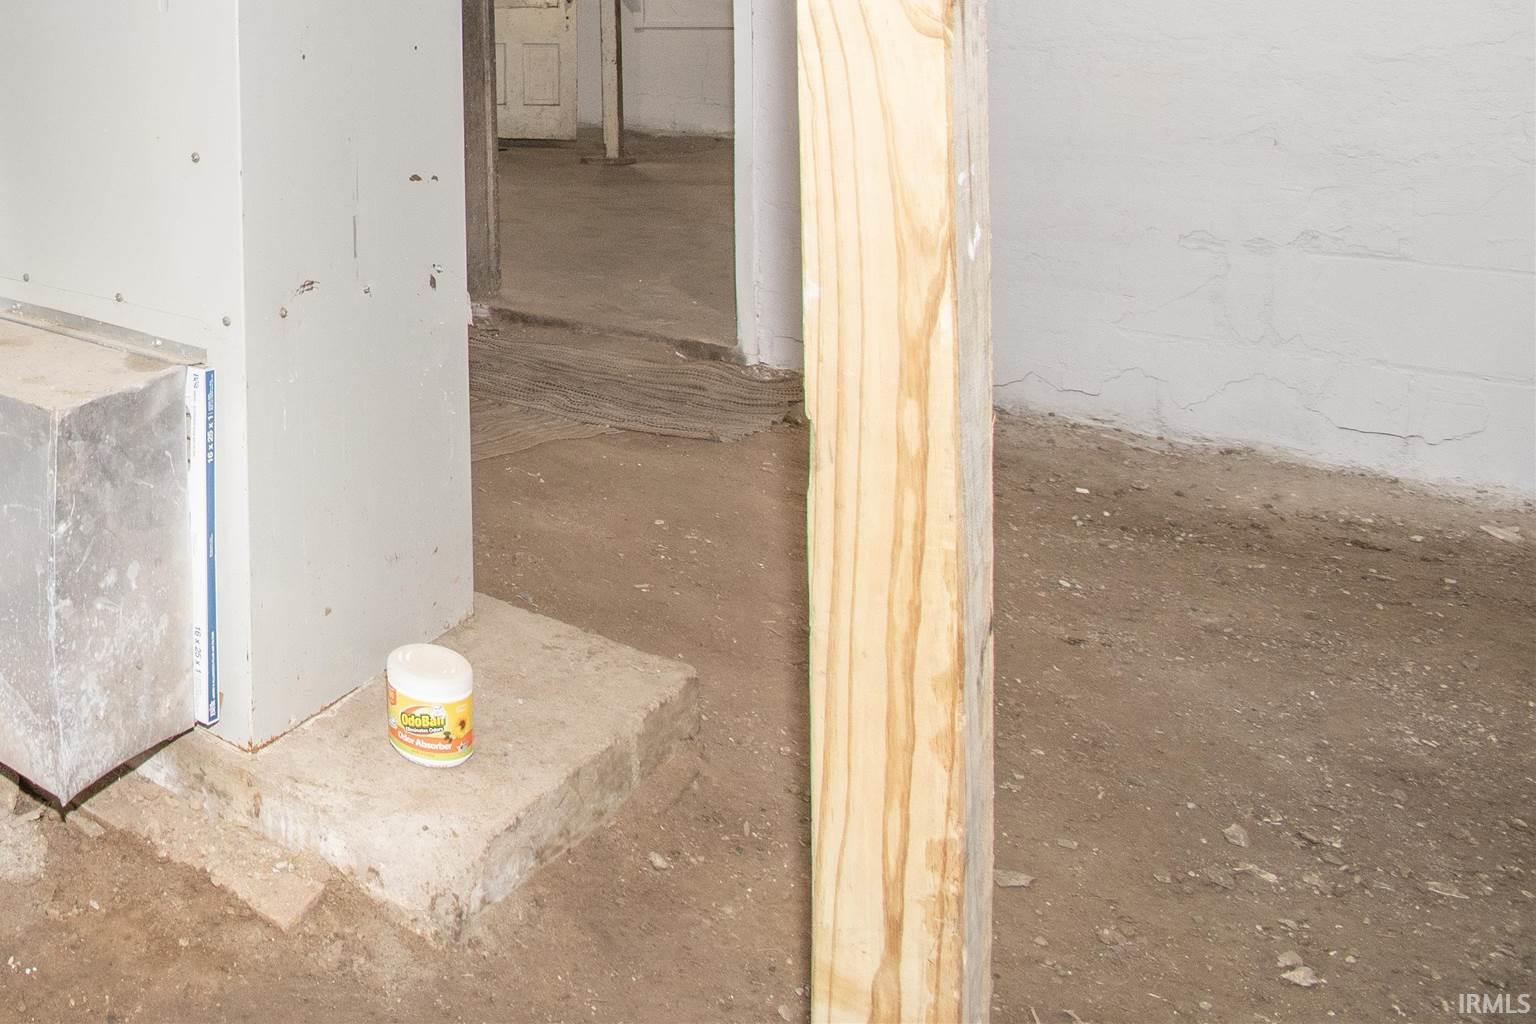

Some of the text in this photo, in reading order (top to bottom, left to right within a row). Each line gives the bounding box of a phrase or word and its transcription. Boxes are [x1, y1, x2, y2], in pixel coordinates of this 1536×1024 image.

[207, 451, 214, 464] 16
[194, 627, 202, 637] 16
[194, 647, 202, 659] 25
[401, 712, 446, 728] OdoBan
[415, 738, 452, 751] Absorber
